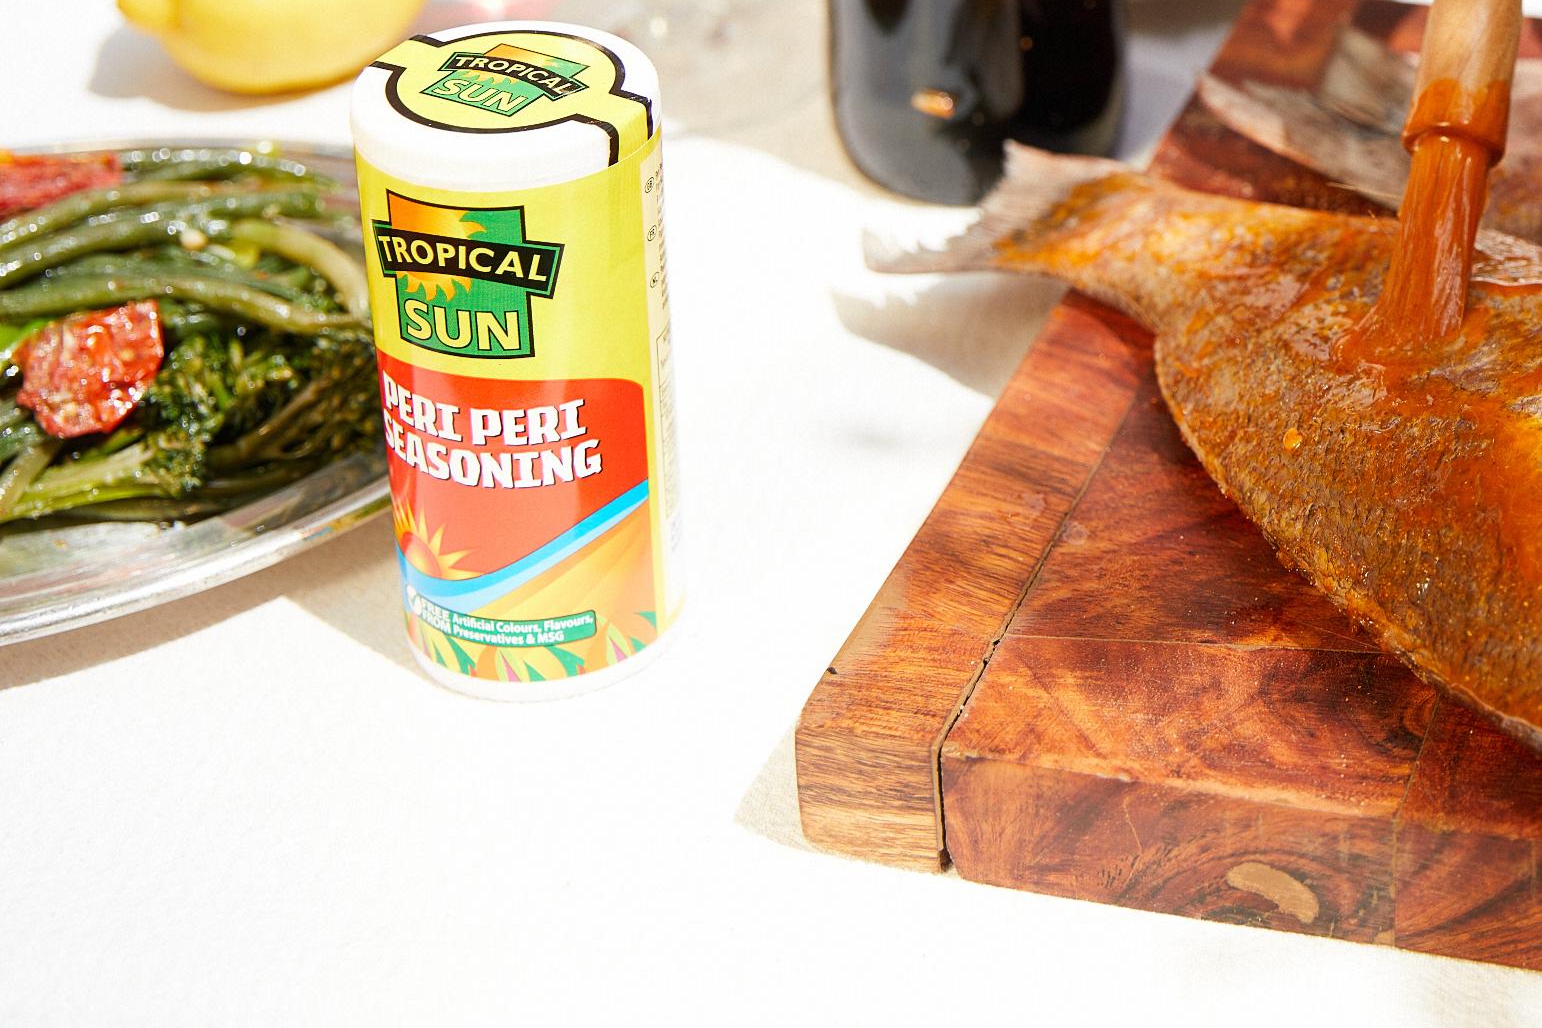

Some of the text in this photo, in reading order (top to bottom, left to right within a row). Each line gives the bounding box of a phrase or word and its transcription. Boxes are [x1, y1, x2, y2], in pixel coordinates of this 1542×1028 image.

[454, 56, 573, 95] TROPICAL
[433, 79, 528, 113] SUN
[377, 235, 549, 282] TROPICAL
[403, 298, 522, 351] SUN
[382, 370, 588, 446] PERI PERI
[383, 408, 603, 489] SEASONING
[421, 598, 450, 620] FREE
[421, 610, 452, 635] FROM
[452, 612, 594, 634] Artificial Colours, Flavours,
[452, 623, 565, 645] Preservatives & MSG
